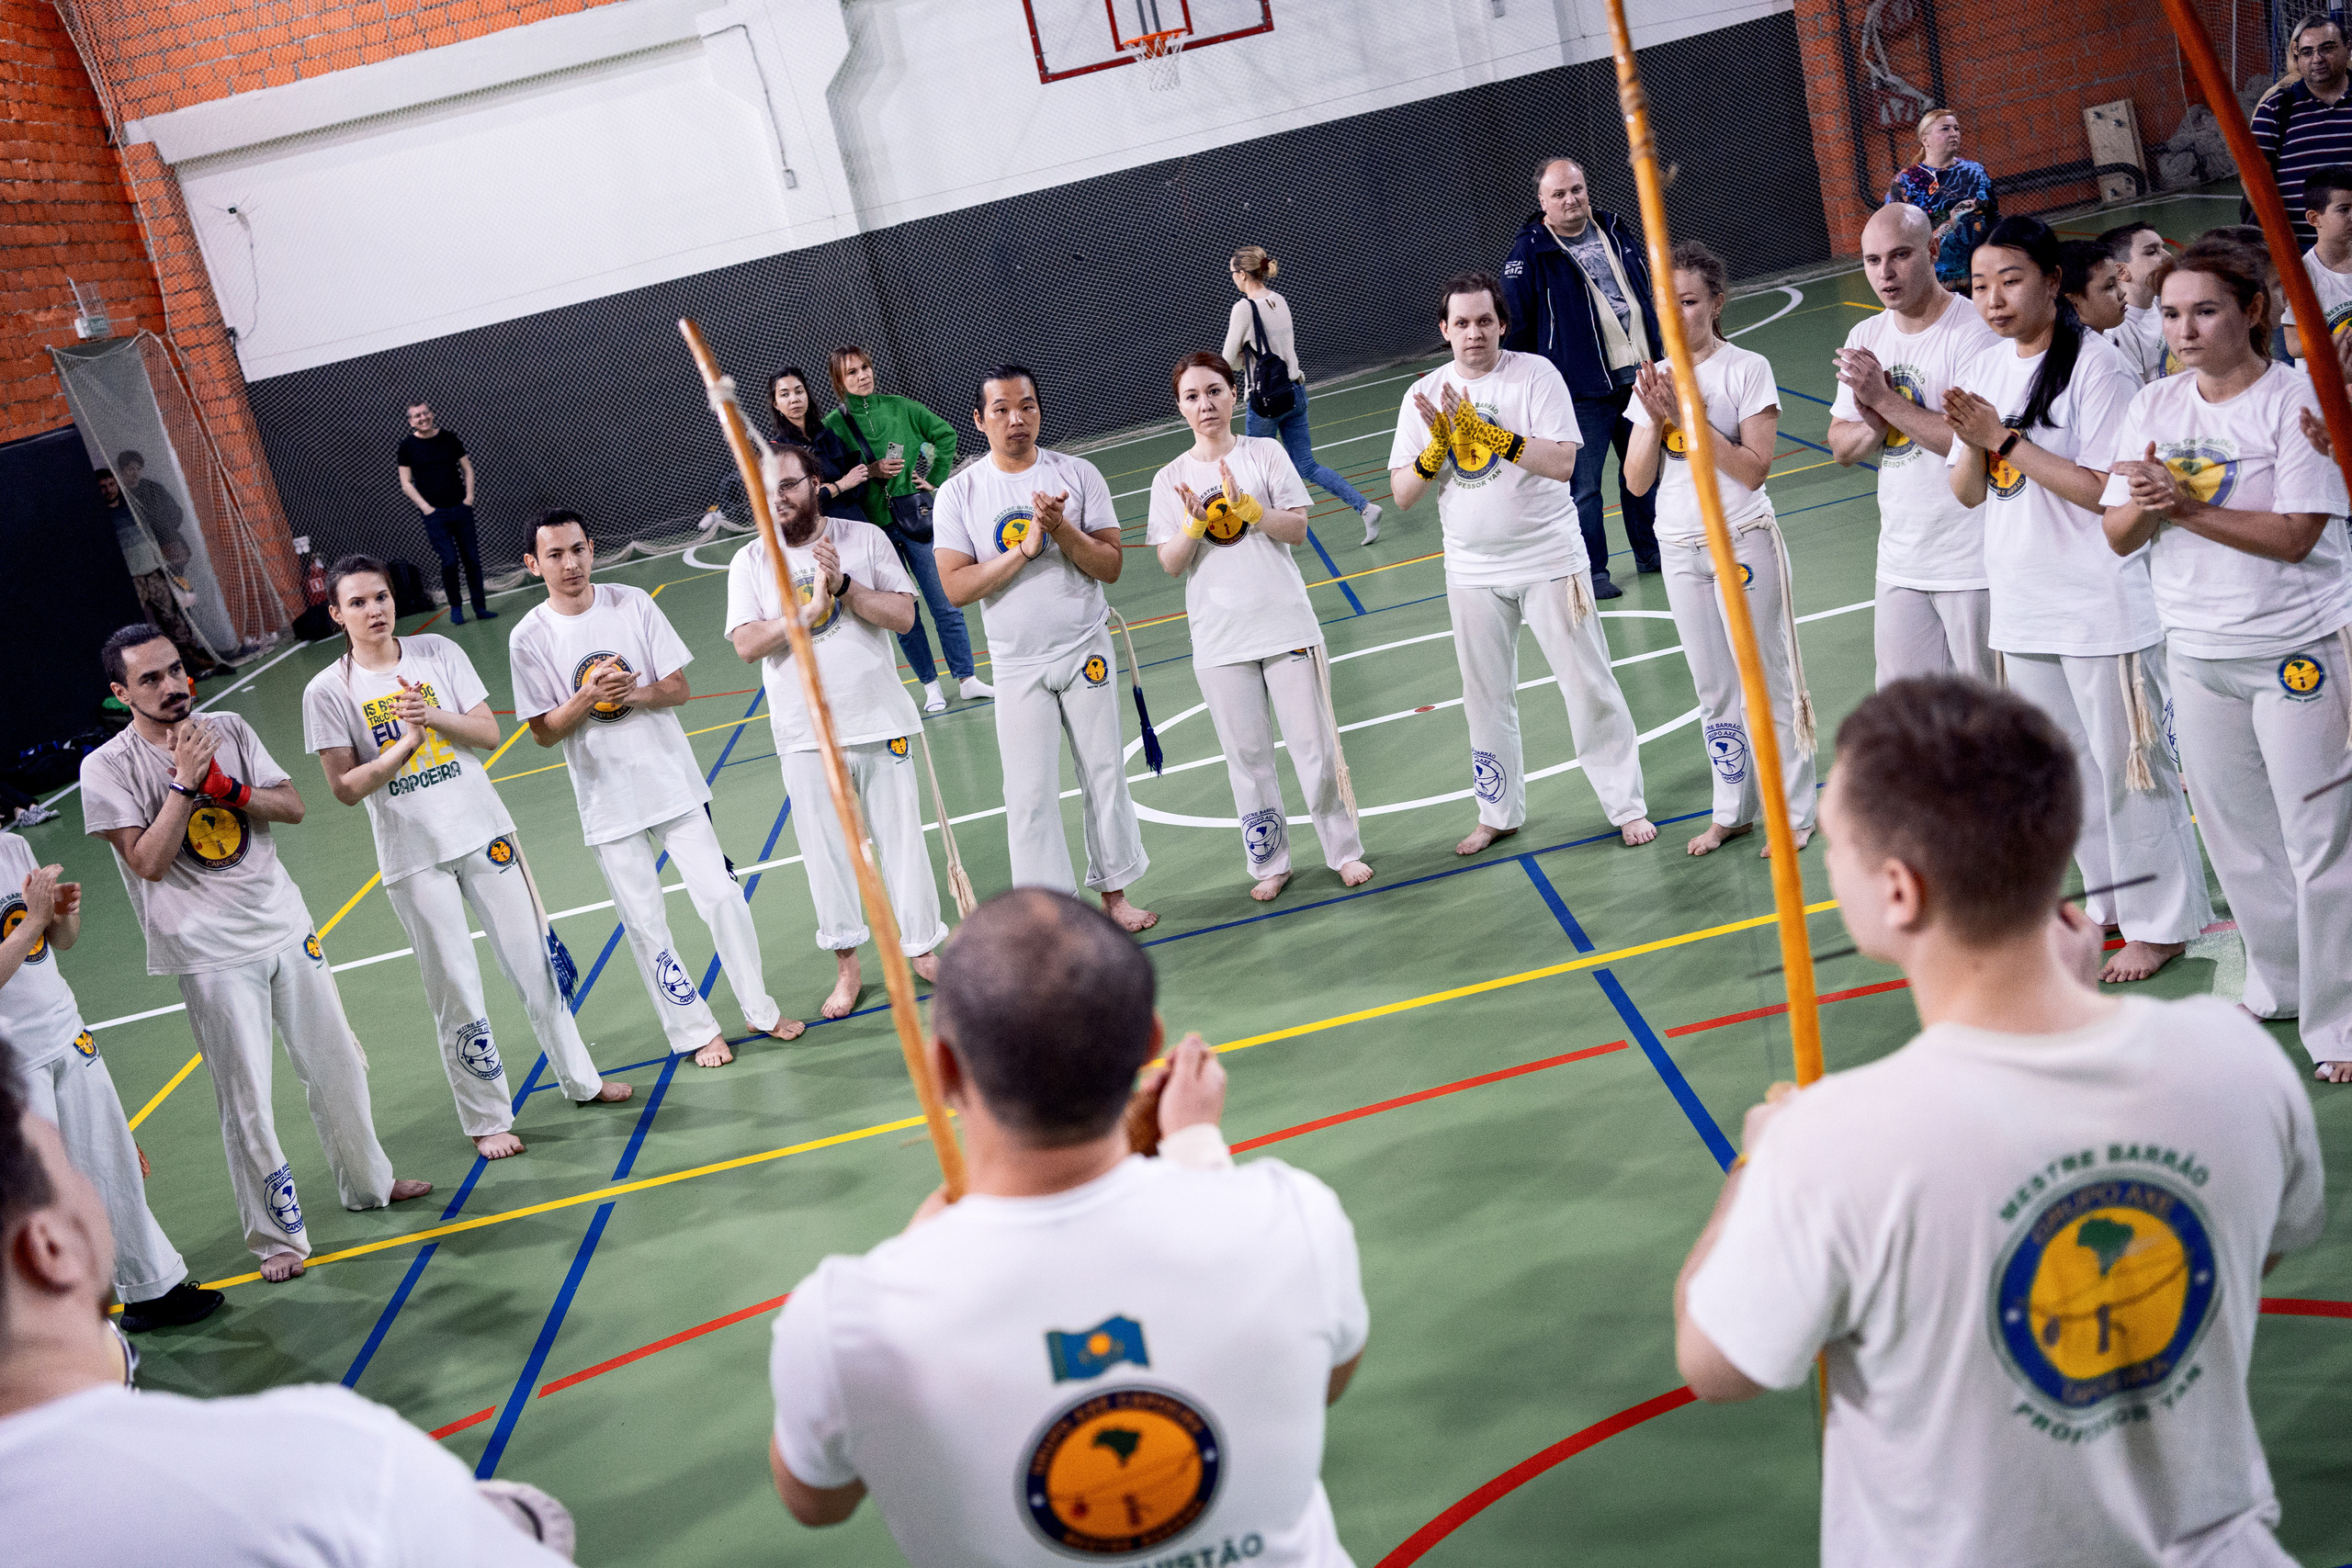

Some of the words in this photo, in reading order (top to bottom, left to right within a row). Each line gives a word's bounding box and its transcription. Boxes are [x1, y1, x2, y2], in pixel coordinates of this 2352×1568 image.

[1883, 460, 1905, 468] ESSOR
[1908, 449, 1923, 463] YAN
[1456, 466, 1490, 478] CAPOEIRA
[1488, 468, 1502, 481] YAN
[993, 506, 1015, 523] MESTRE
[827, 625, 842, 637] YAN
[575, 665, 587, 687] GRUPO
[388, 761, 462, 796] CAPOEIRA
[206, 852, 242, 868] CAPOEIRA
[464, 1027, 483, 1041] GRUPO
[1999, 1148, 2095, 1222] MESTRE
